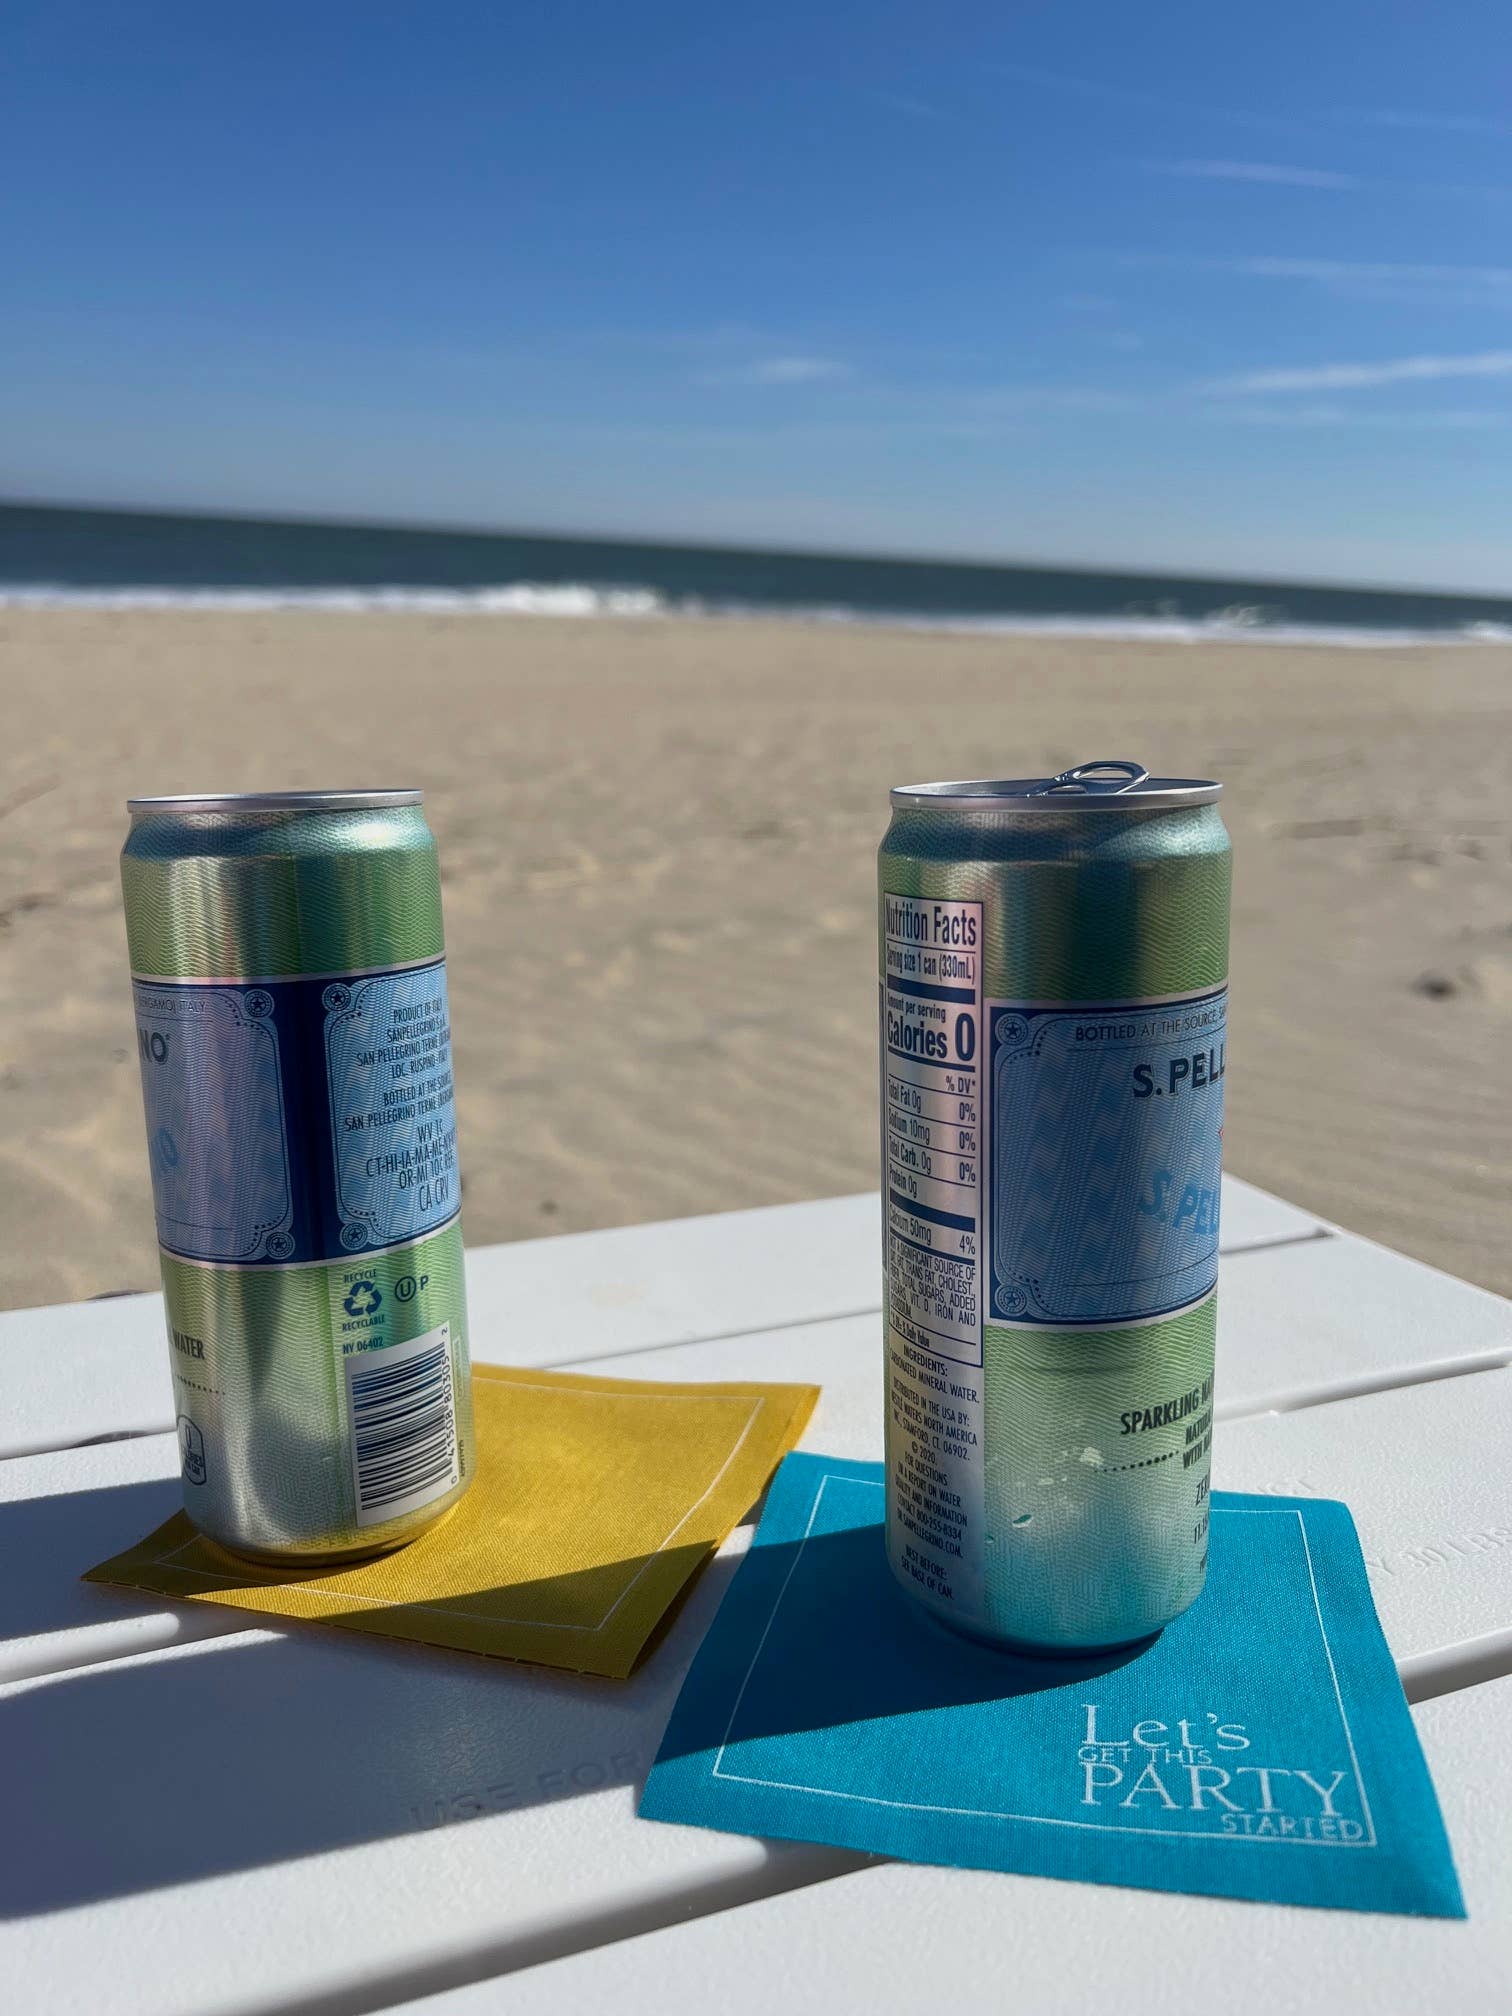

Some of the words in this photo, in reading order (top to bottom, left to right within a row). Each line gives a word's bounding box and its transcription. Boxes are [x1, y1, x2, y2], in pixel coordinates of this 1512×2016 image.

[885, 899, 928, 941] Nutrition
[933, 906, 976, 946] Facts
[904, 949, 915, 973] size
[924, 956, 936, 976] can
[938, 953, 976, 985] (330mL)
[393, 1004, 423, 1023] PRODUCT
[905, 1000, 916, 1016] per
[917, 1005, 946, 1023] serving
[887, 1010, 948, 1059] Calories
[954, 1012, 976, 1062] 0
[1075, 1026, 1136, 1041] BOTTLED
[1141, 1023, 1156, 1037] AT
[1161, 1020, 1181, 1035] THE
[357, 1051, 374, 1066] SAN
[378, 1041, 420, 1062] PELLEGRINO
[383, 1086, 416, 1106] BOTTLED
[900, 1086, 911, 1106] Fat
[911, 1090, 922, 1113] 0g
[959, 1102, 976, 1122] 0%
[344, 1115, 364, 1132] SAN
[368, 1104, 416, 1127] PELLEGRINO
[910, 1119, 930, 1145] 10mg
[959, 1131, 976, 1151] 0%
[900, 1143, 919, 1166] Carb.
[921, 1151, 932, 1175] 0g
[959, 1162, 976, 1182] 0%
[419, 1184, 433, 1211] CA
[908, 1175, 918, 1198] 0g
[910, 1218, 932, 1246] 50mg
[959, 1234, 976, 1255] 4%
[343, 1268, 377, 1283] RECYCLE
[934, 1258, 963, 1278] SOURCE
[965, 1266, 976, 1281] OF
[934, 1304, 954, 1321] IRON
[958, 1310, 976, 1327] AND
[949, 1294, 976, 1311] ADDED
[342, 1314, 385, 1331] RECYCLABLE
[172, 1328, 205, 1360] WATER
[343, 1343, 355, 1354] NY
[357, 1336, 384, 1352] 06402
[903, 1344, 948, 1376] INGREDIENTS:
[918, 1372, 948, 1394] MINERAL
[949, 1383, 980, 1404] WATER.
[928, 1399, 940, 1416] THE
[941, 1406, 955, 1421] USA
[957, 1412, 970, 1427] BY:
[1120, 1387, 1200, 1435] SPARKLING
[923, 1417, 944, 1434] NORTH
[945, 1426, 978, 1446] AMERICA
[943, 1440, 971, 1461] 06902.
[915, 1458, 948, 1486] QUESTIONS
[911, 1491, 922, 1505] AND
[923, 1497, 968, 1526] INFORMATION
[928, 1484, 937, 1497] ON
[939, 1489, 961, 1507] WATER
[905, 1544, 919, 1561] BEST
[1081, 1704, 1250, 1750] Let's
[1078, 1746, 1132, 1763] GET
[1148, 1747, 1213, 1765] THIS
[1081, 1760, 1347, 1818] PARTY
[1220, 1813, 1364, 1841] STARTED
